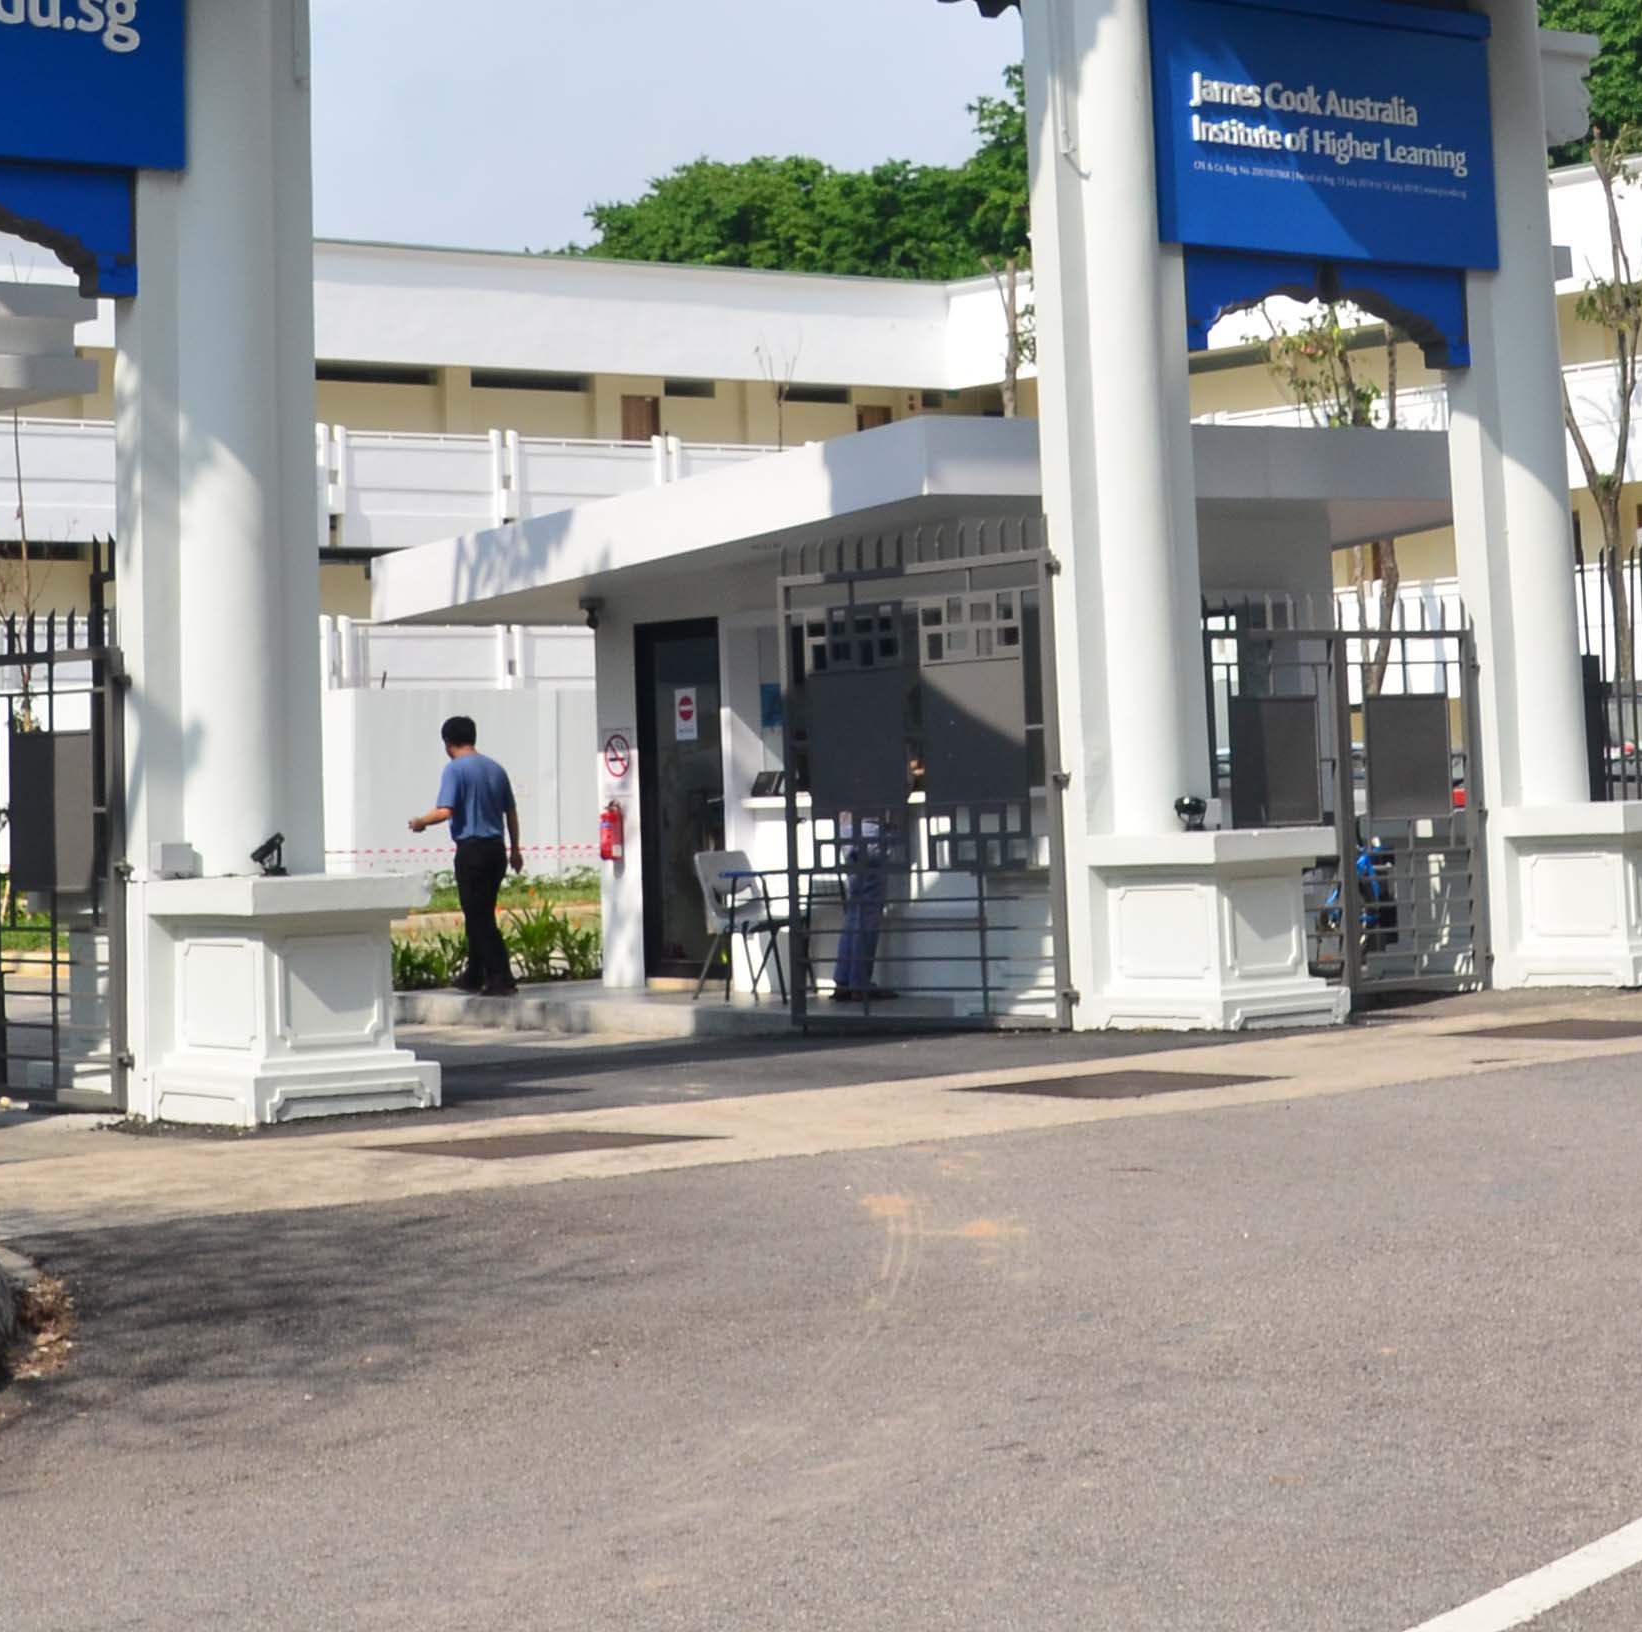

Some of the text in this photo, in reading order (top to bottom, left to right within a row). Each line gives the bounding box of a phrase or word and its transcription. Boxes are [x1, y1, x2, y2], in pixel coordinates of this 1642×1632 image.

[1189, 71, 1418, 127] James Cook Australia
[1191, 114, 1468, 177] Institute of Higher Learning
